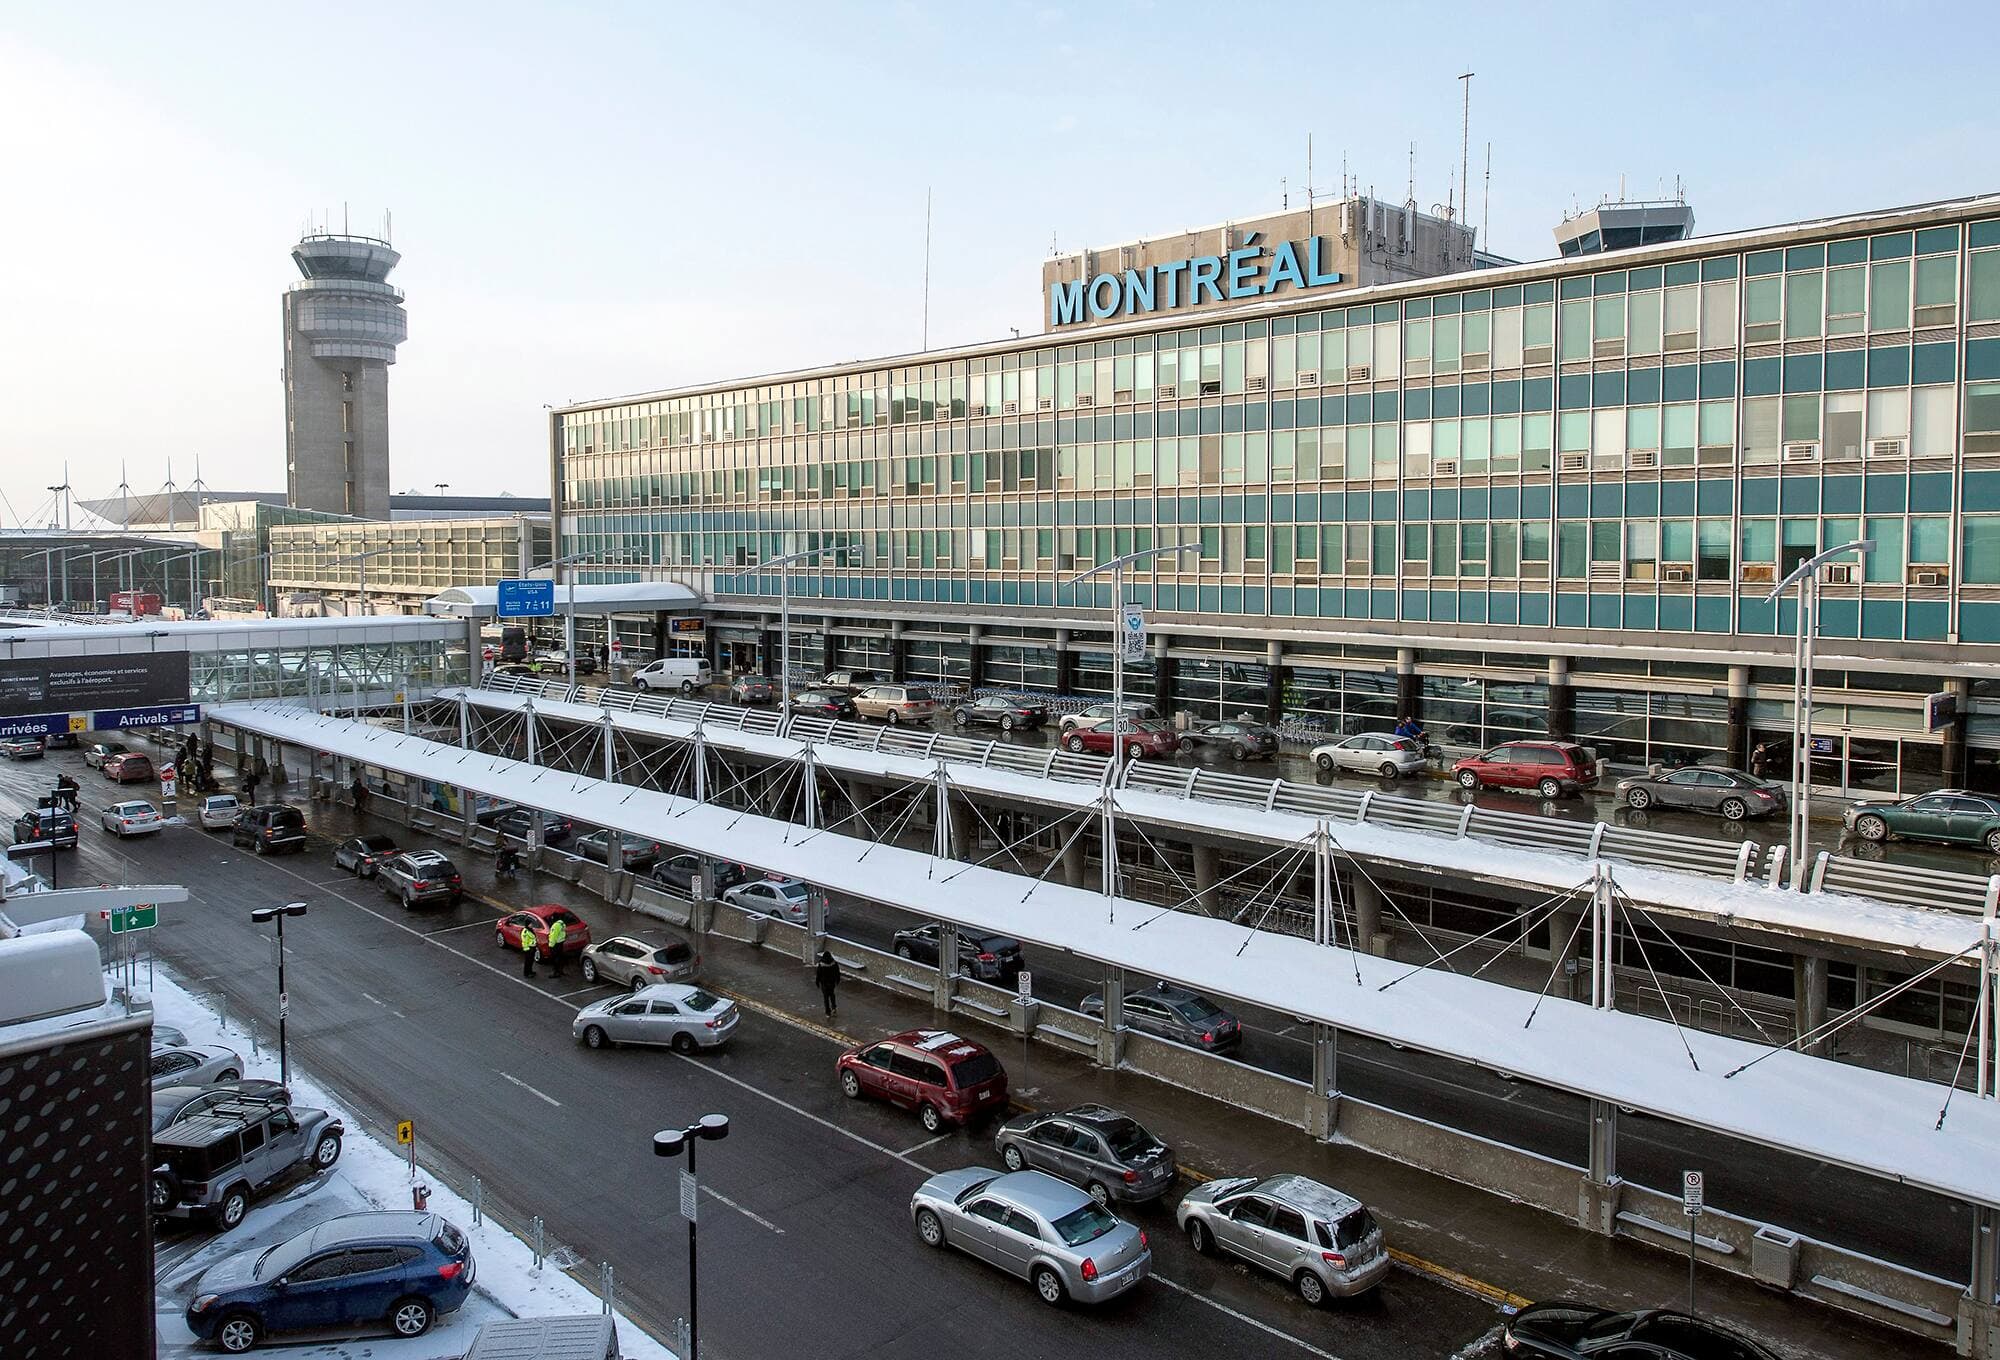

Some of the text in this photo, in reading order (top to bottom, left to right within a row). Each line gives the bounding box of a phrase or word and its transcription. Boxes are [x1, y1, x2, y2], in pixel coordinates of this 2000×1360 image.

[1051, 232, 1343, 326] MONTRÉAL
[525, 601, 531, 610] 7
[540, 601, 550, 609] 11
[84, 669, 116, 677] économies
[50, 678, 76, 686] exclusifs
[119, 713, 168, 726] Arrivals
[0, 723, 48, 736] rrivées
[1118, 720, 1128, 733] 30
